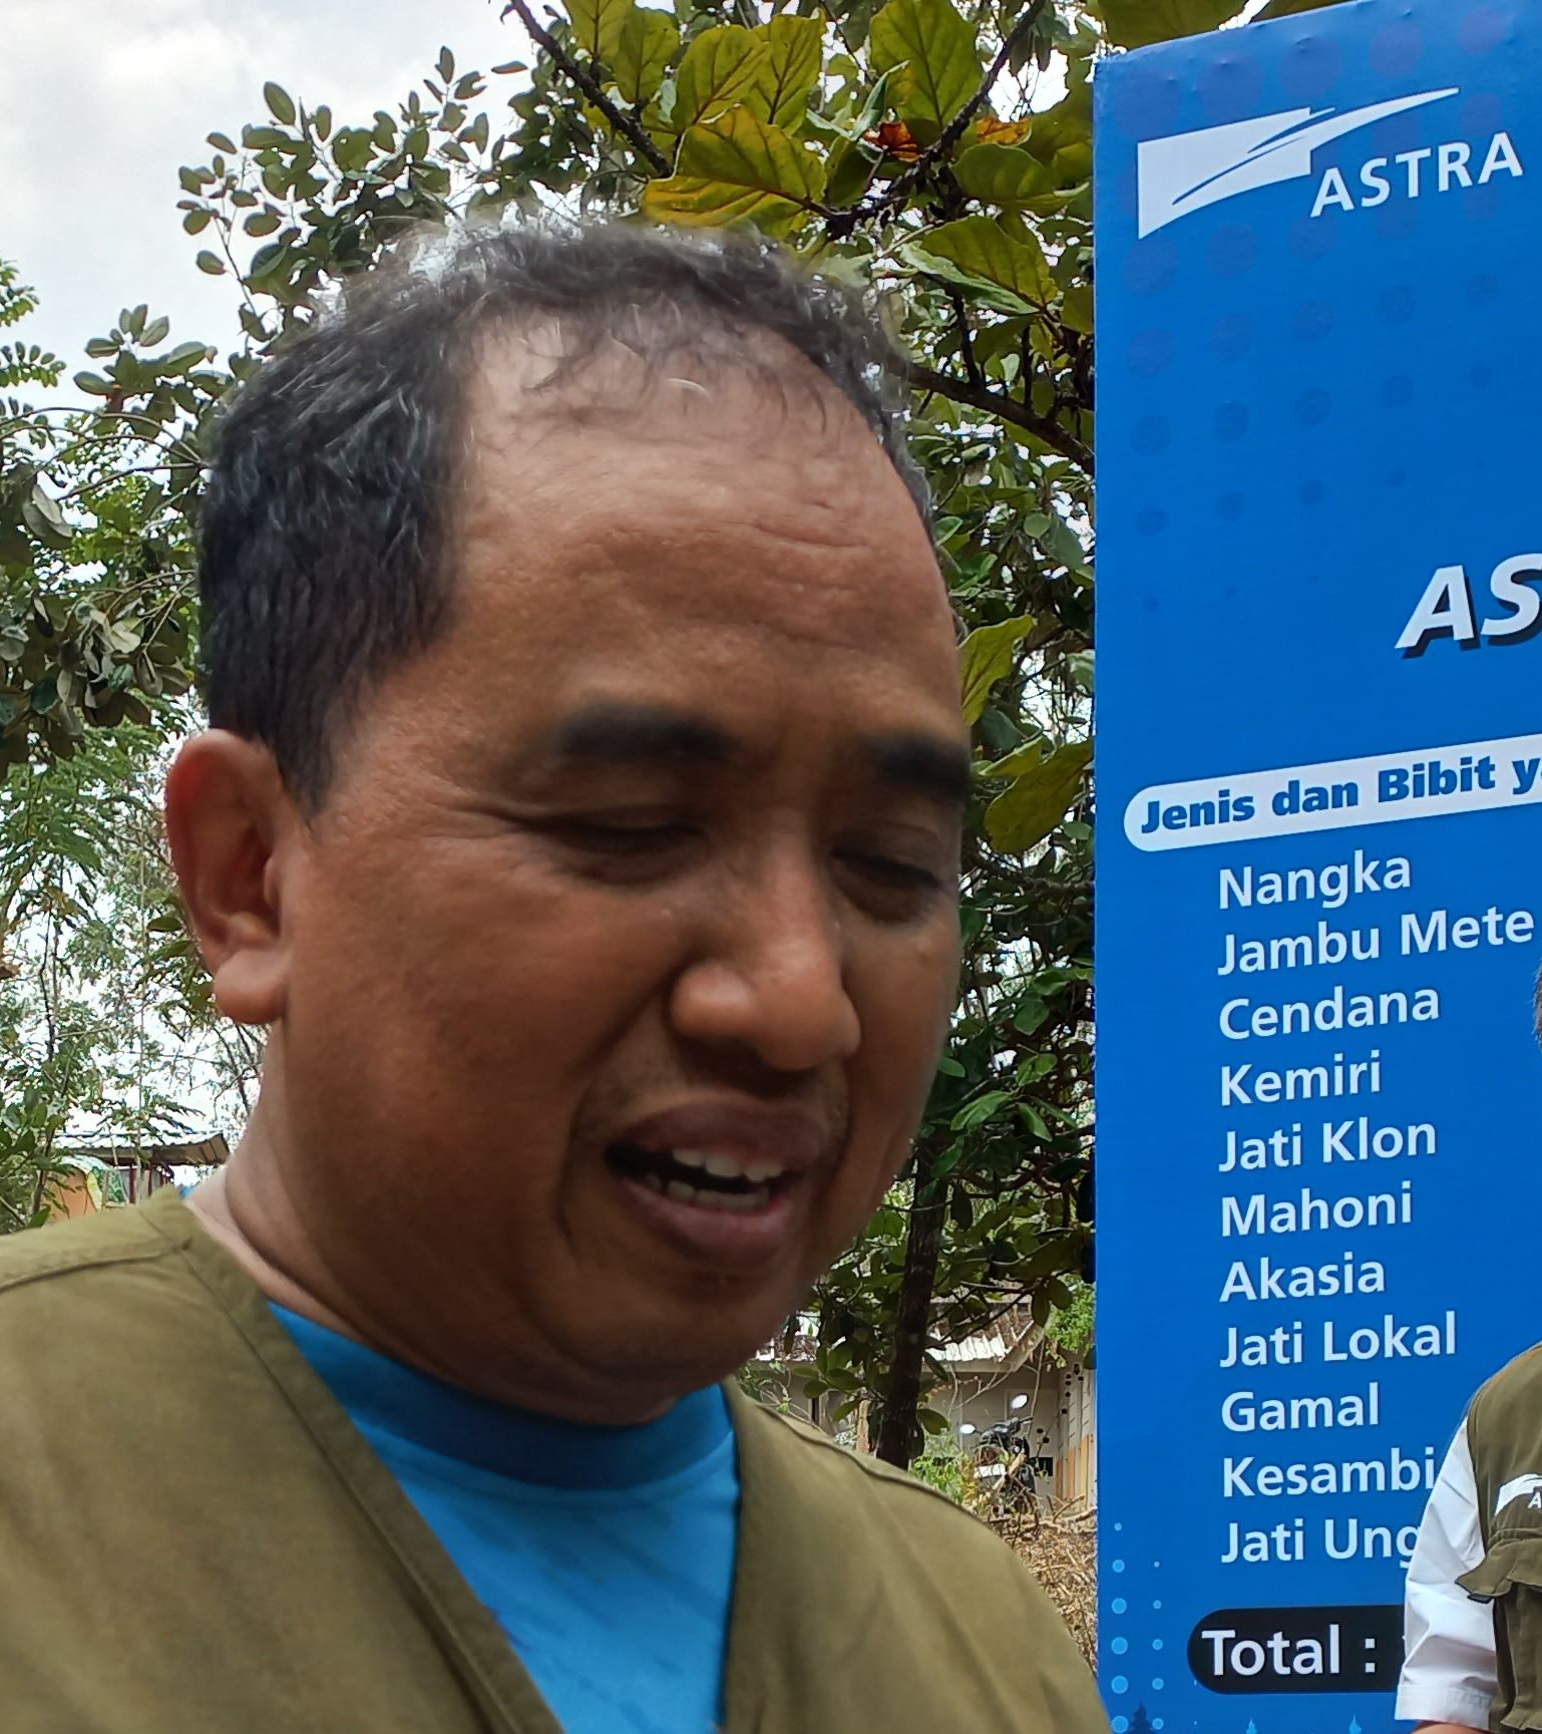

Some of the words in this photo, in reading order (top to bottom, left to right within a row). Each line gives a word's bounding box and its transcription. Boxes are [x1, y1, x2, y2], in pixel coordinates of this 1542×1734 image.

[1310, 131, 1524, 217] ASTRA
[1140, 788, 1256, 834] Jenis
[1271, 779, 1360, 817] dan
[1377, 755, 1496, 803] Bibit
[1218, 849, 1411, 909] Nangka
[1217, 920, 1380, 976] Jambu
[1400, 905, 1535, 956] Mete
[1219, 985, 1440, 1041] Cendana
[1220, 1049, 1381, 1106] Kemiri
[1219, 1123, 1302, 1172] Jati
[1322, 1117, 1437, 1163] Klon
[1220, 1180, 1412, 1238] Mahoni
[1219, 1250, 1385, 1303] Akasia
[1219, 1320, 1303, 1369] Jati
[1323, 1310, 1457, 1361] Lokal
[1221, 1382, 1379, 1433] Gamal
[1223, 1446, 1435, 1498] Kesambi
[1220, 1517, 1305, 1564] Jati
[1200, 1623, 1341, 1677] Total
